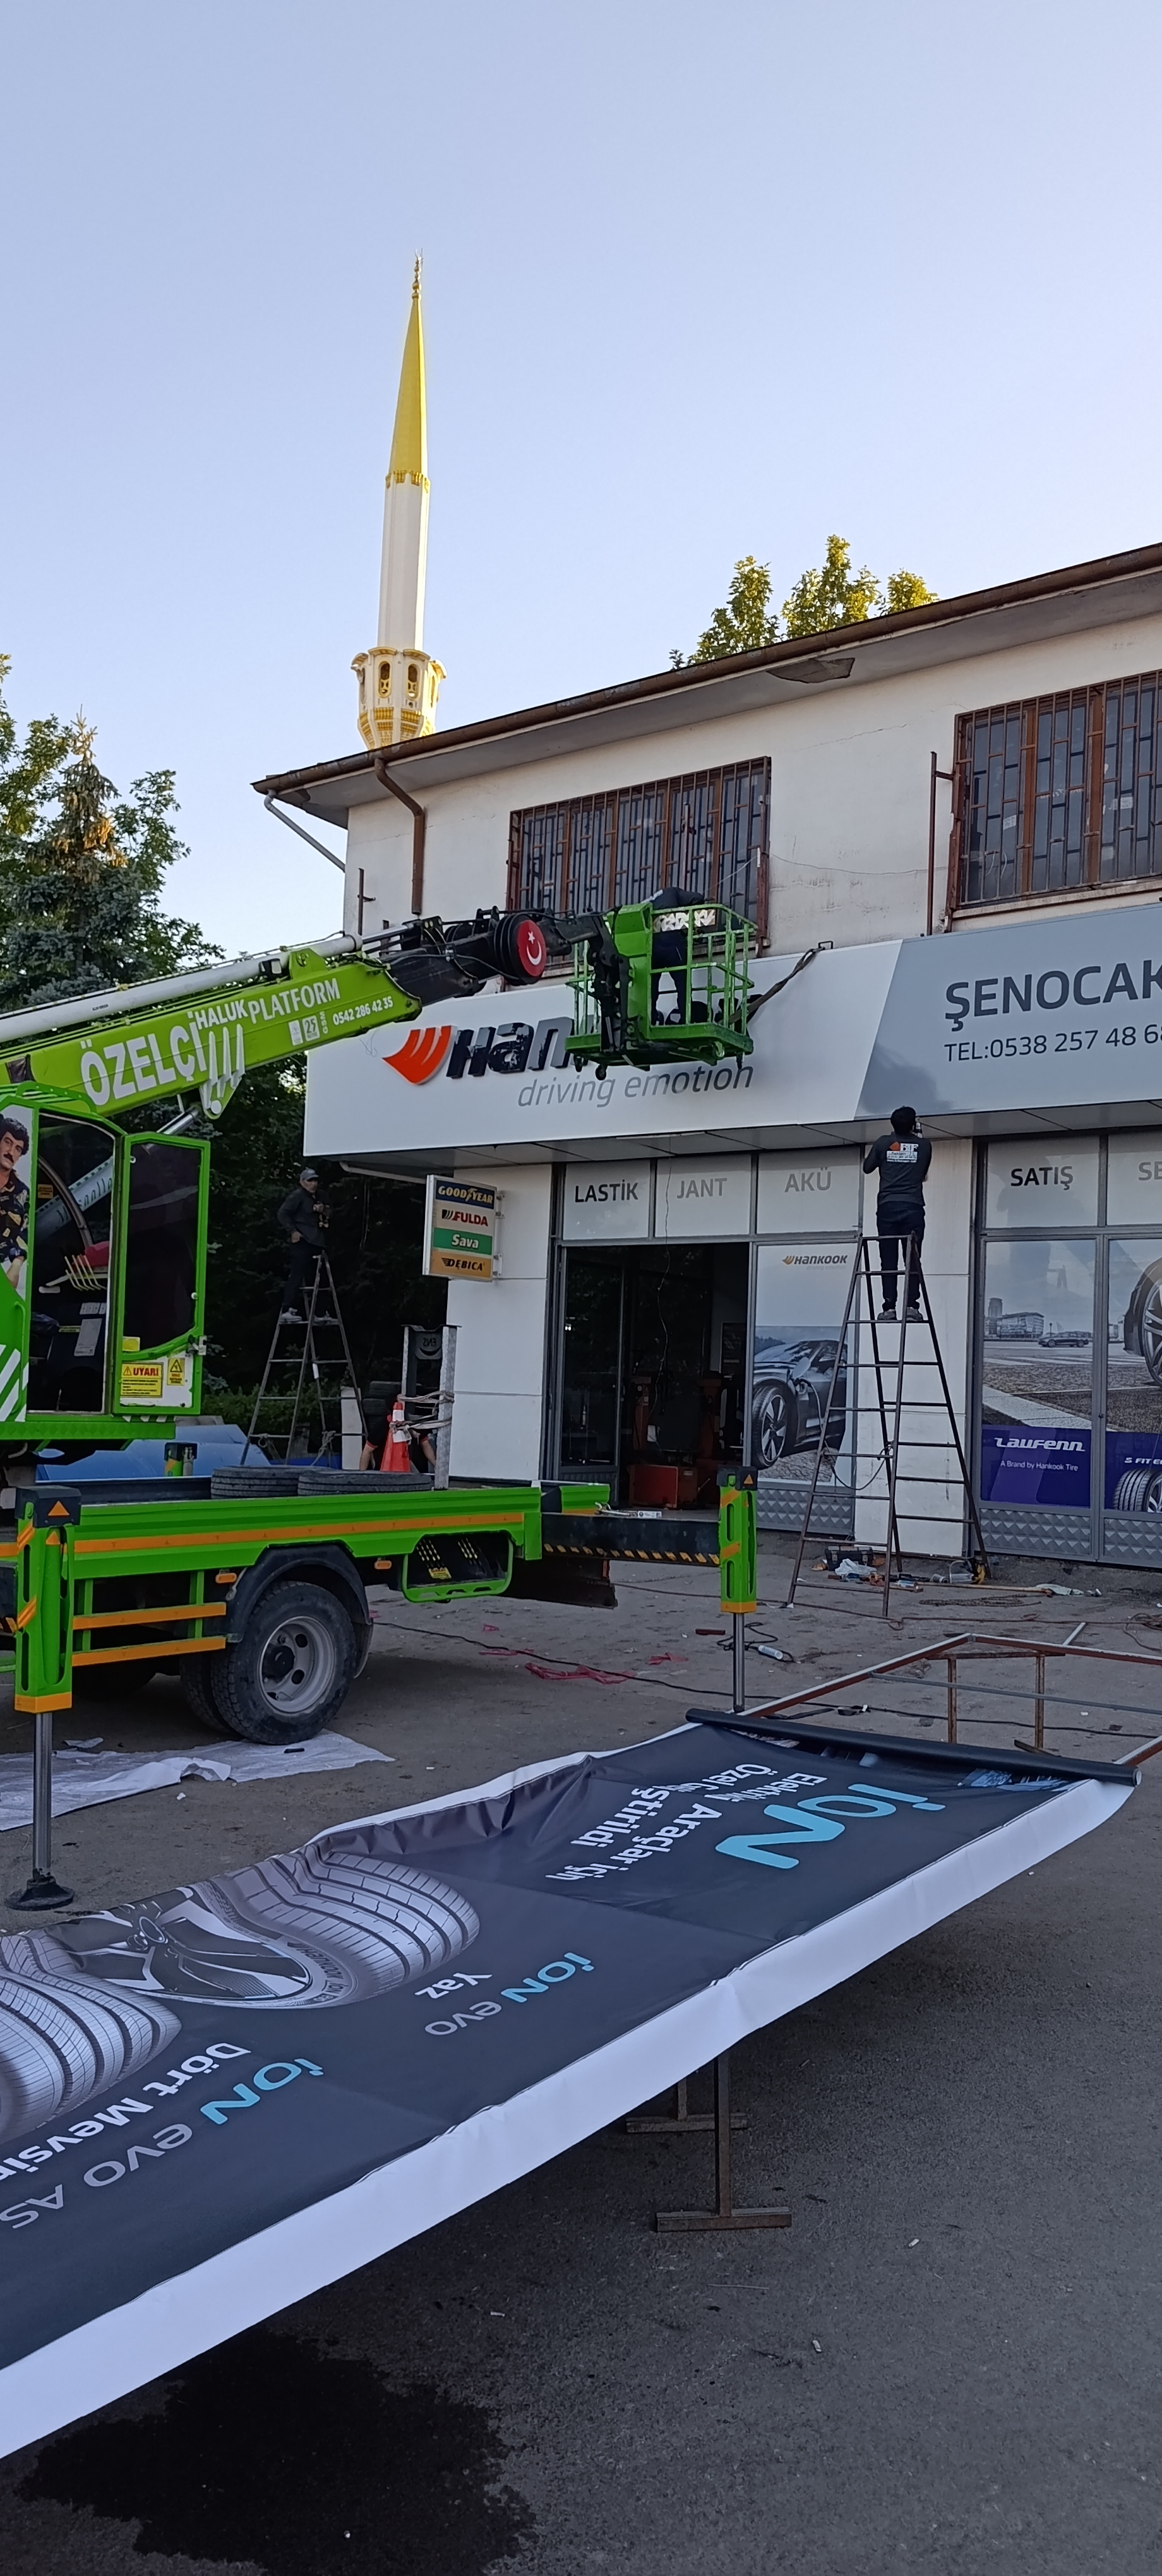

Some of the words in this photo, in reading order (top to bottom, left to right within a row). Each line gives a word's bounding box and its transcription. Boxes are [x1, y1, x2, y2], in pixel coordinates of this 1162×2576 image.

[249, 977, 340, 1024] PLATFORM
[945, 960, 1162, 1031] ŞENOCAK
[196, 998, 248, 1030] HALUK
[320, 1011, 328, 1034] GSM
[333, 1008, 355, 1025] 0542
[355, 1003, 371, 1018] 286
[372, 999, 383, 1012] 42
[383, 996, 393, 1009] 35
[305, 1018, 316, 1034] 25
[944, 1035, 1047, 1062] TEL:0538
[1055, 1029, 1099, 1052] 257
[1105, 1026, 1137, 1047] 48
[1144, 1024, 1162, 1044] 6
[80, 1011, 208, 1106] ÖZELÇİ
[518, 1075, 616, 1108] driving
[624, 1065, 753, 1098] emotion
[574, 1179, 639, 1203] LASTİK
[676, 1177, 728, 1199] JANT
[784, 1167, 832, 1193] AKÜ
[1010, 1165, 1074, 1190] SATIŞ
[438, 1186, 493, 1204] GOODYEAR
[452, 1211, 488, 1227] FULDA
[452, 1234, 479, 1248] Sava
[1027, 1461, 1034, 1470] by
[1036, 1462, 1064, 1470] Hankook
[702, 1763, 777, 1786] Özel
[610, 1803, 722, 1864] Araçlar
[545, 1863, 629, 1880] için
[414, 1972, 493, 1999] Yaz
[425, 2001, 502, 2035] evo
[142, 2042, 251, 2097] Dört
[83, 2123, 193, 2187] evo
[0, 2184, 64, 2229] AS
